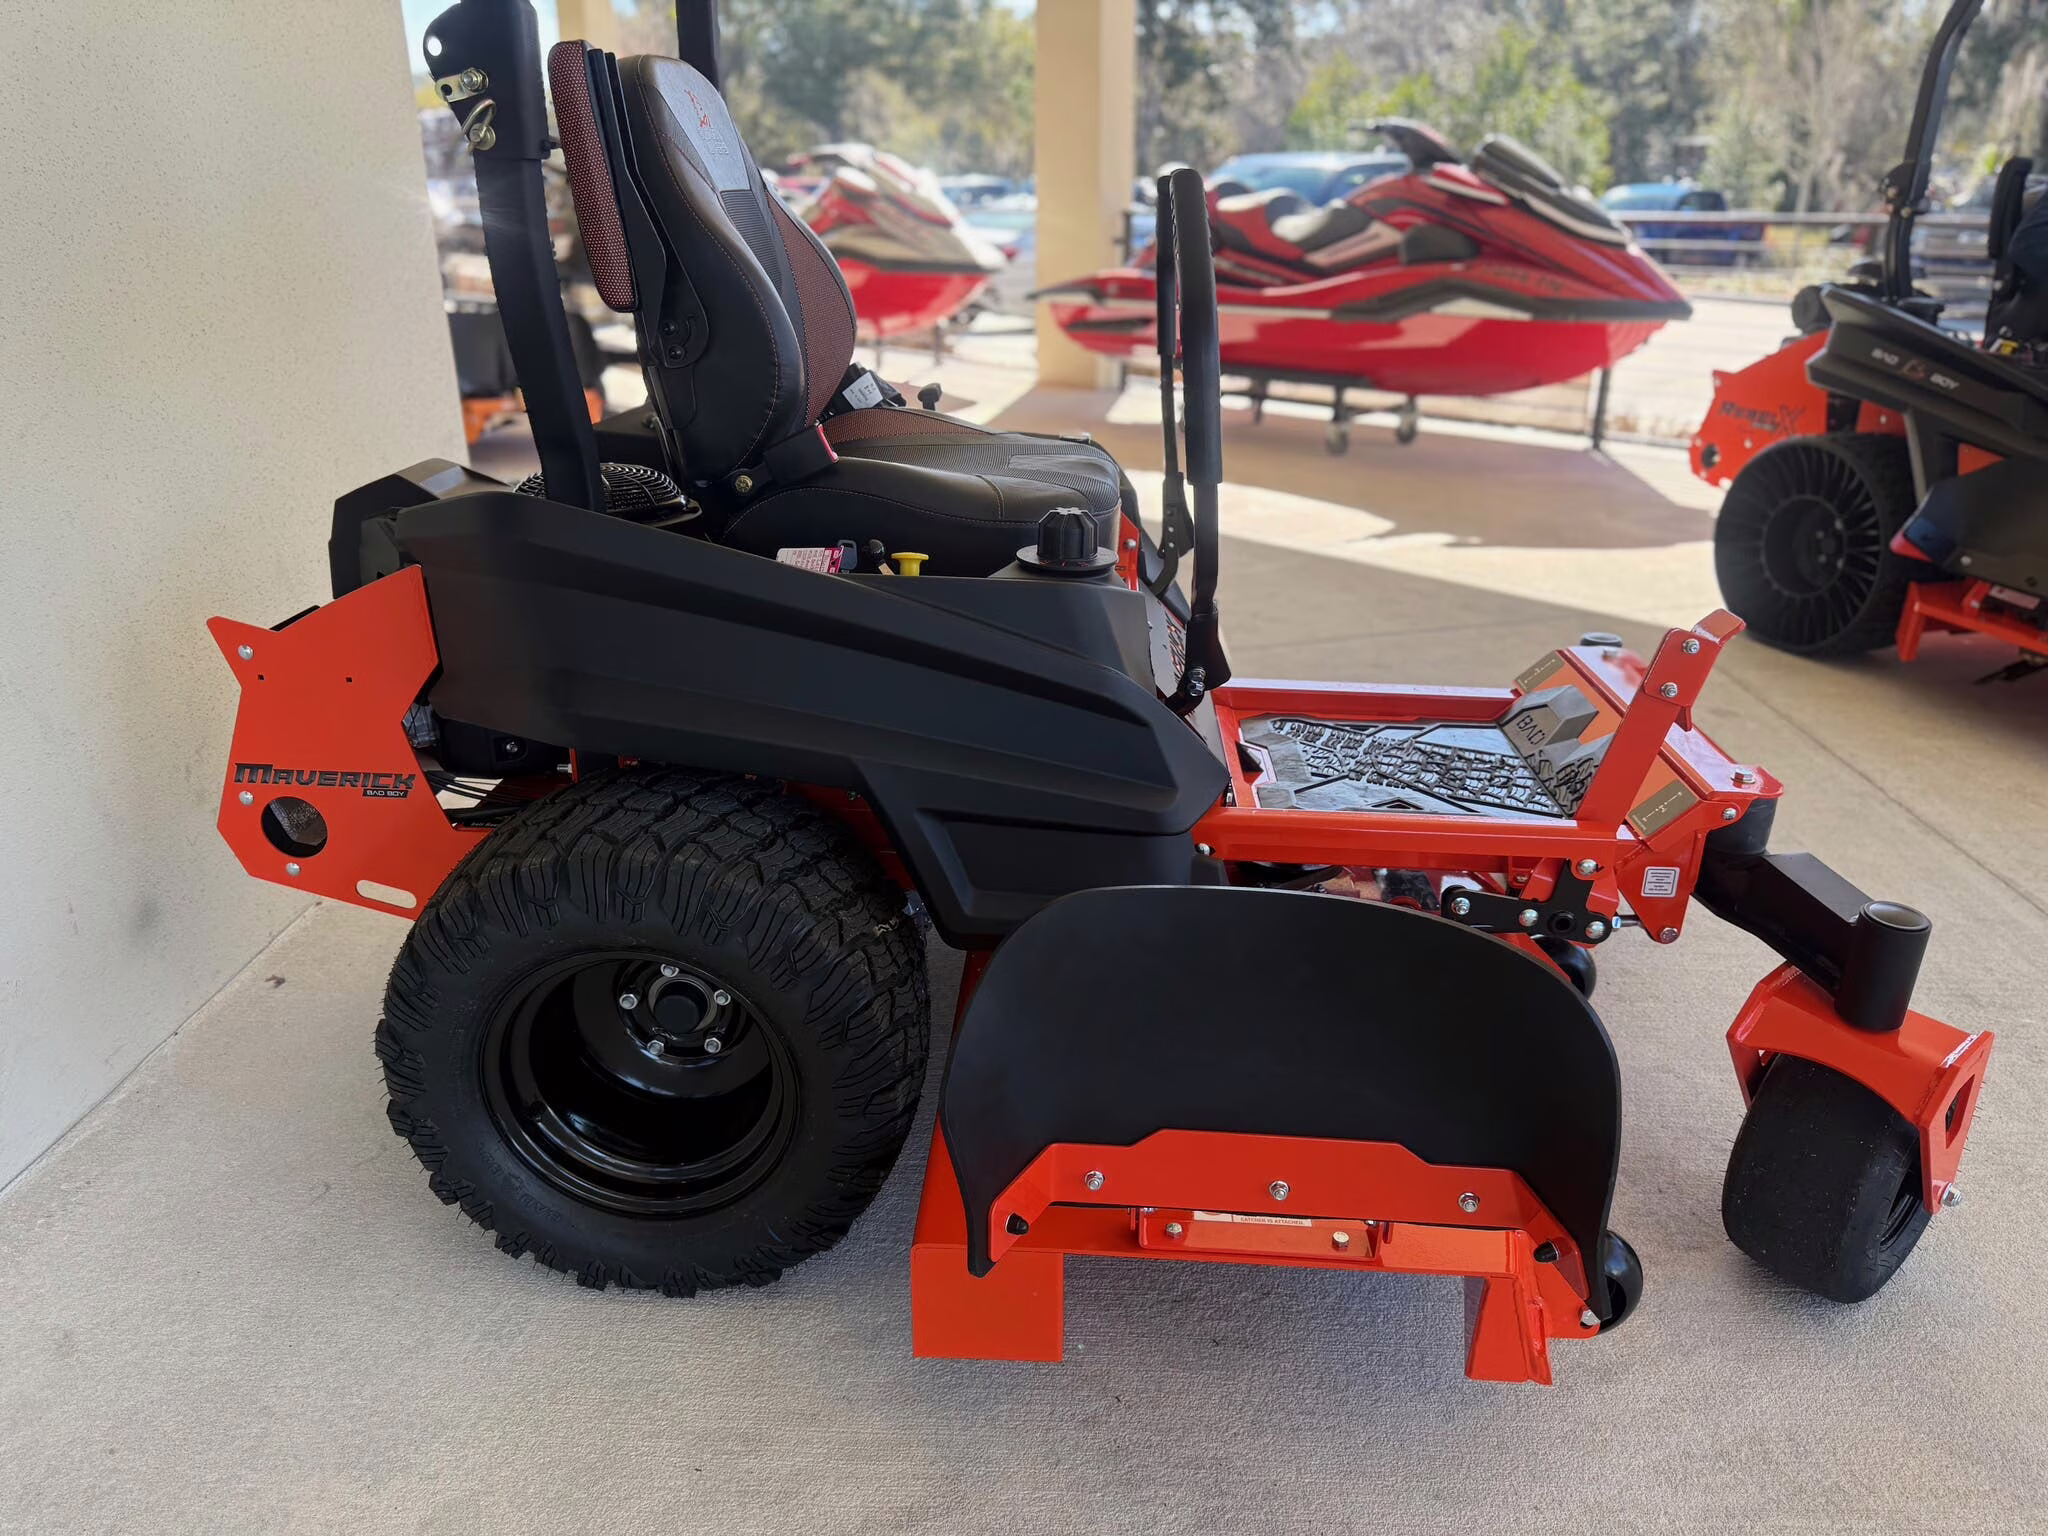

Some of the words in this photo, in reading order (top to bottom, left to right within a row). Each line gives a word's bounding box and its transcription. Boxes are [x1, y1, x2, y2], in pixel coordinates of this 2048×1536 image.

[1871, 348, 1899, 366] BAD
[1930, 372, 1960, 390] BOY
[234, 762, 417, 790] MAVERICK
[366, 789, 385, 797] BAD
[387, 790, 405, 798] BOY
